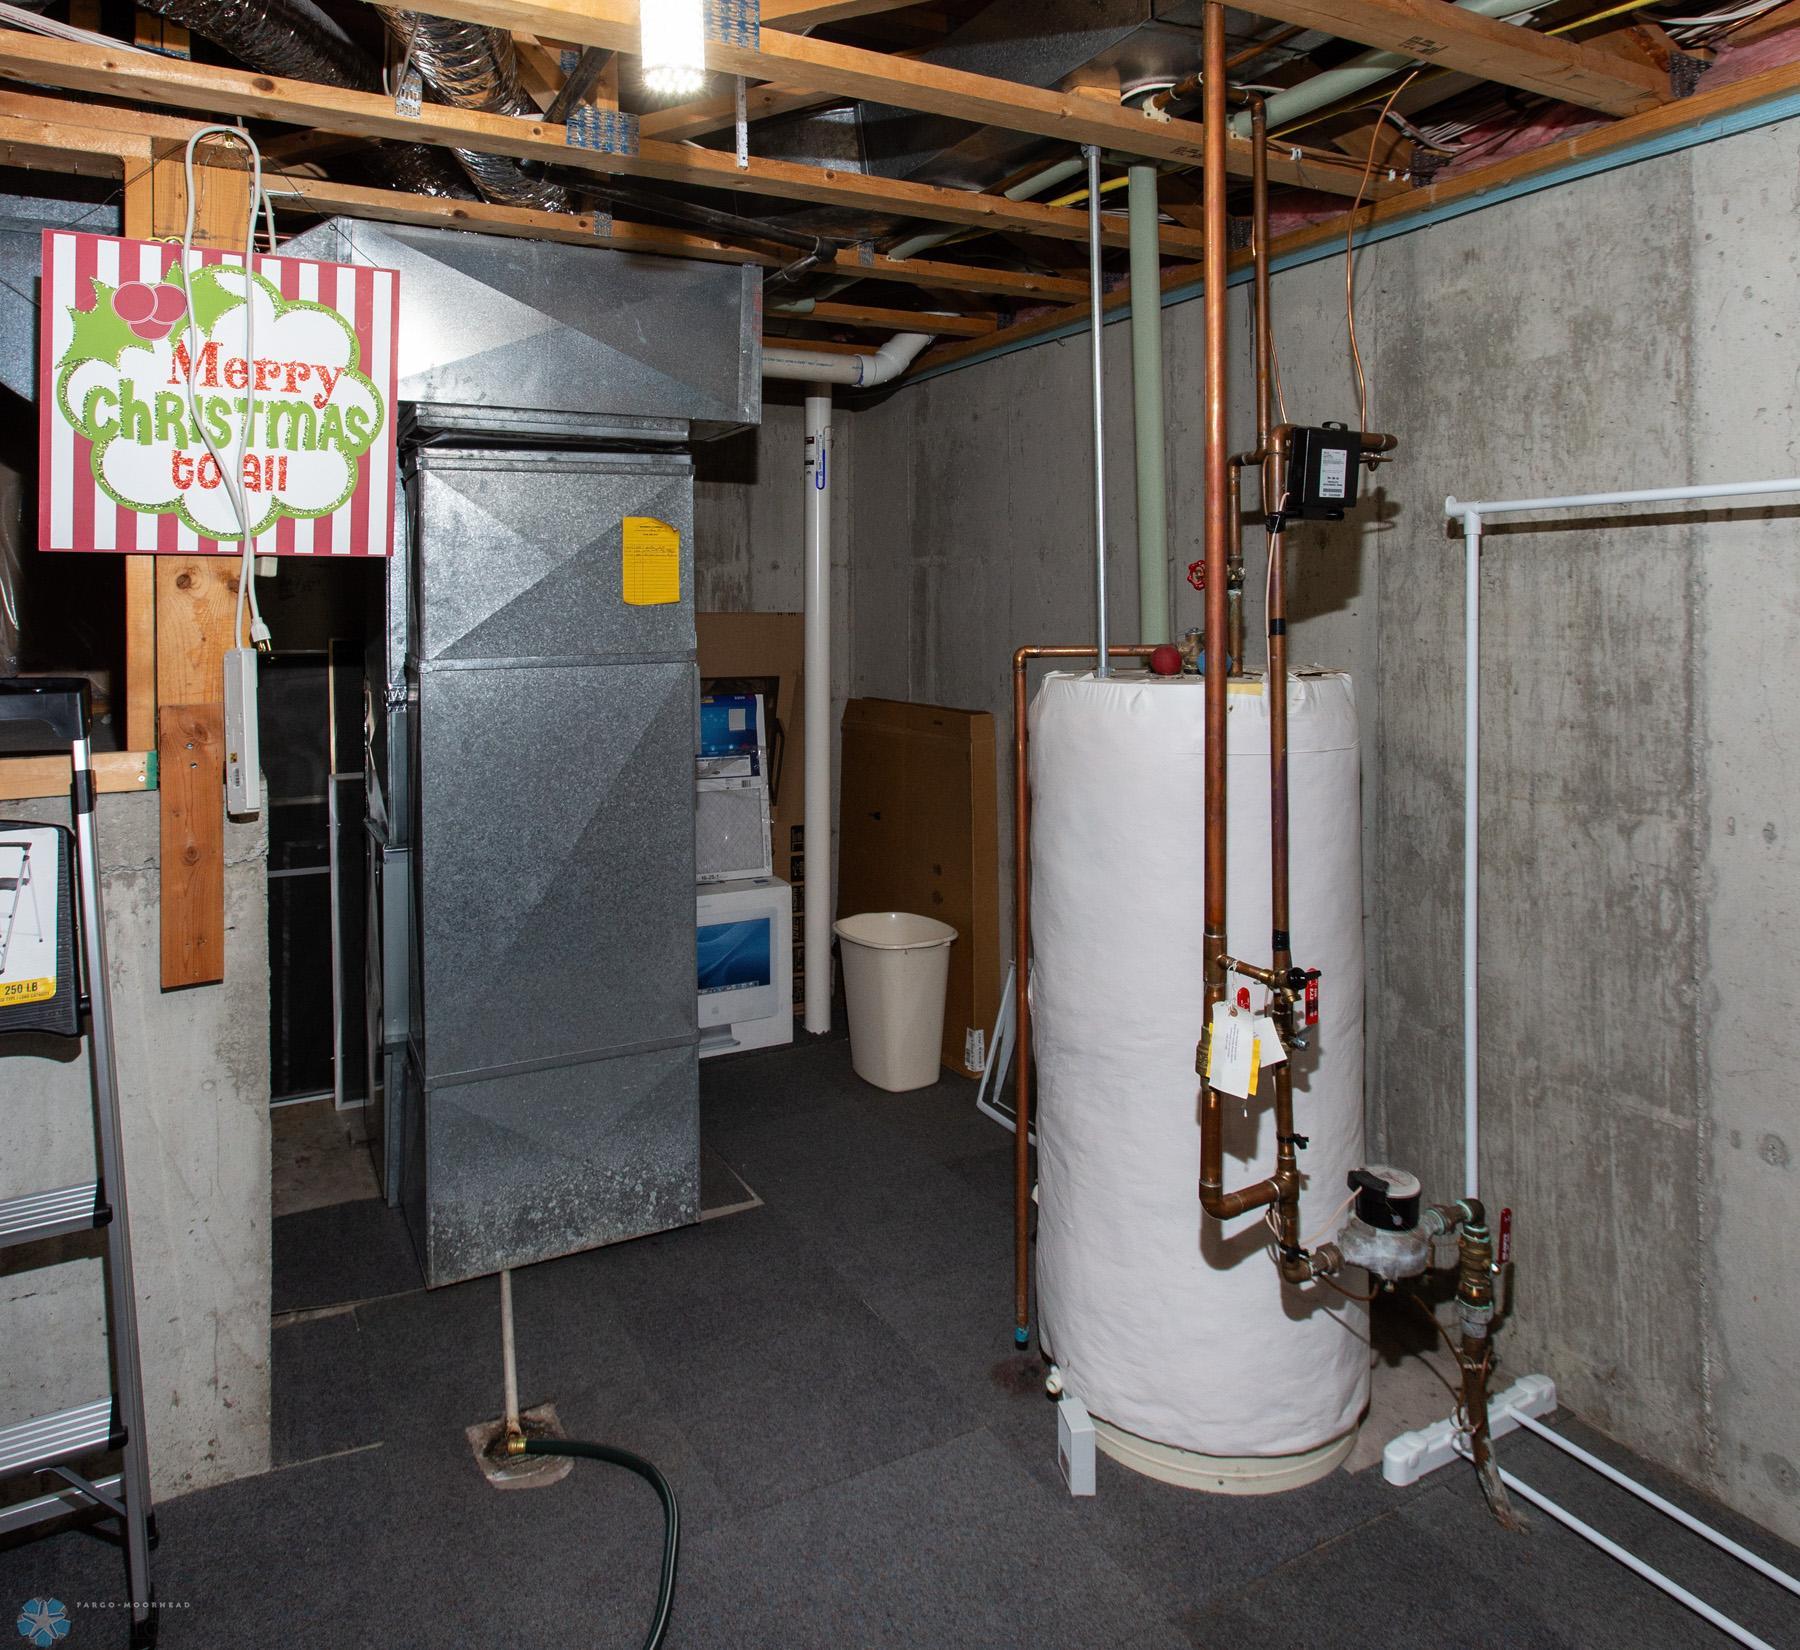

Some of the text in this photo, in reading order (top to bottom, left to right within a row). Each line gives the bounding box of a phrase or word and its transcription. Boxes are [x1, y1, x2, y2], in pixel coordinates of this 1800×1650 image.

[167, 339, 345, 409] Merry
[172, 450, 288, 493] to all
[5, 981, 38, 996] 250 LB
